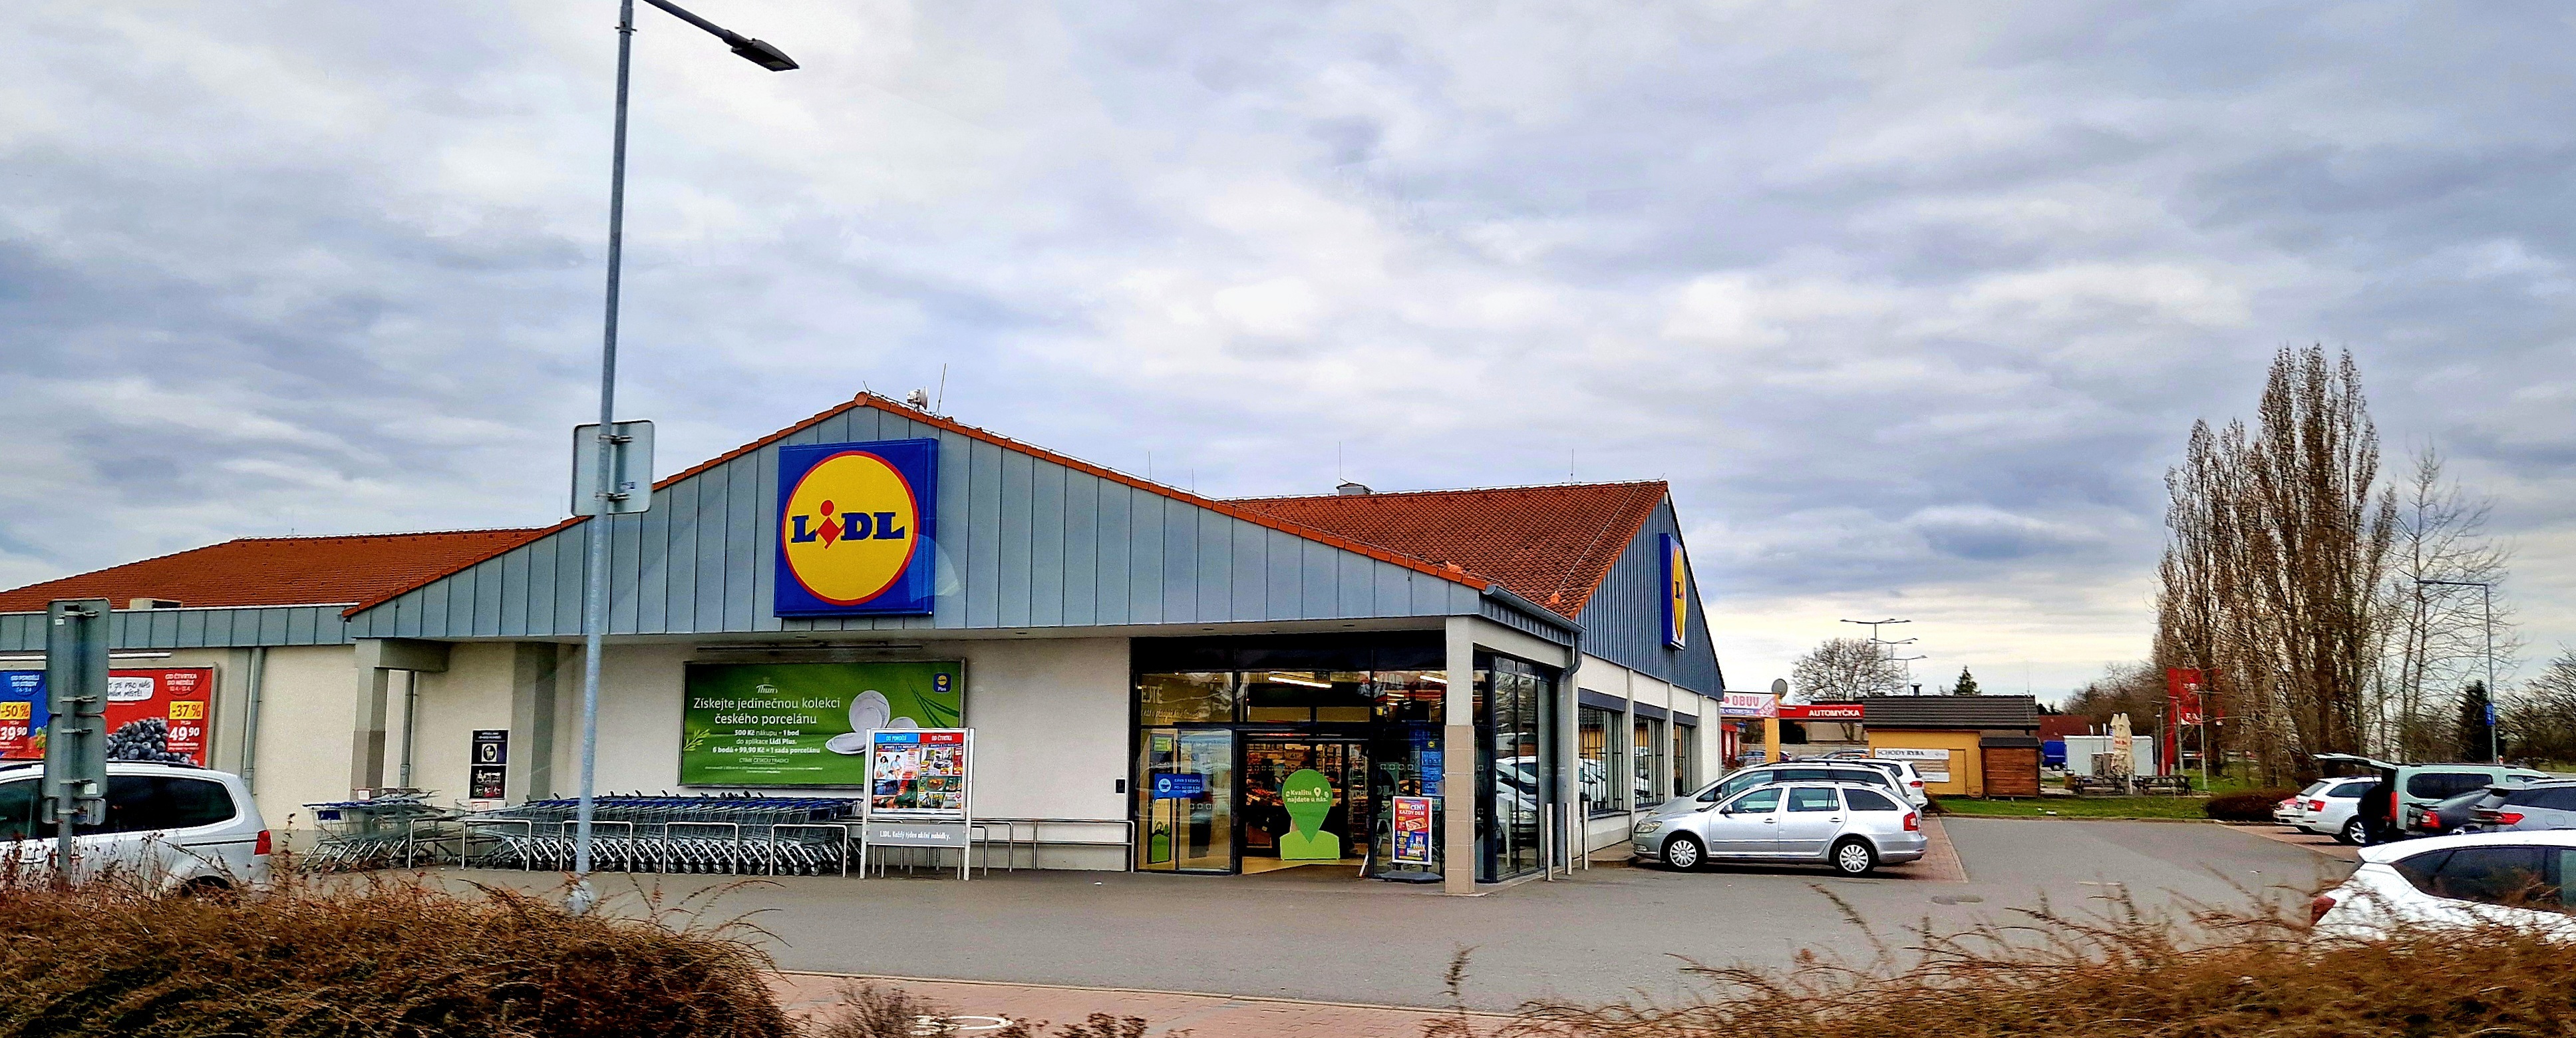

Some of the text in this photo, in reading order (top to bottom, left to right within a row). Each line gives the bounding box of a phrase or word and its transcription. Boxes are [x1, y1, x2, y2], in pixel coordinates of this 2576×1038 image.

[693, 697, 840, 711] Získejte jedinečnou kolekci
[1732, 695, 1759, 707] OBUV
[1808, 708, 1860, 717] AUTOMYČKA
[715, 713, 817, 726] českého porcelánu
[893, 830, 905, 839] Každý
